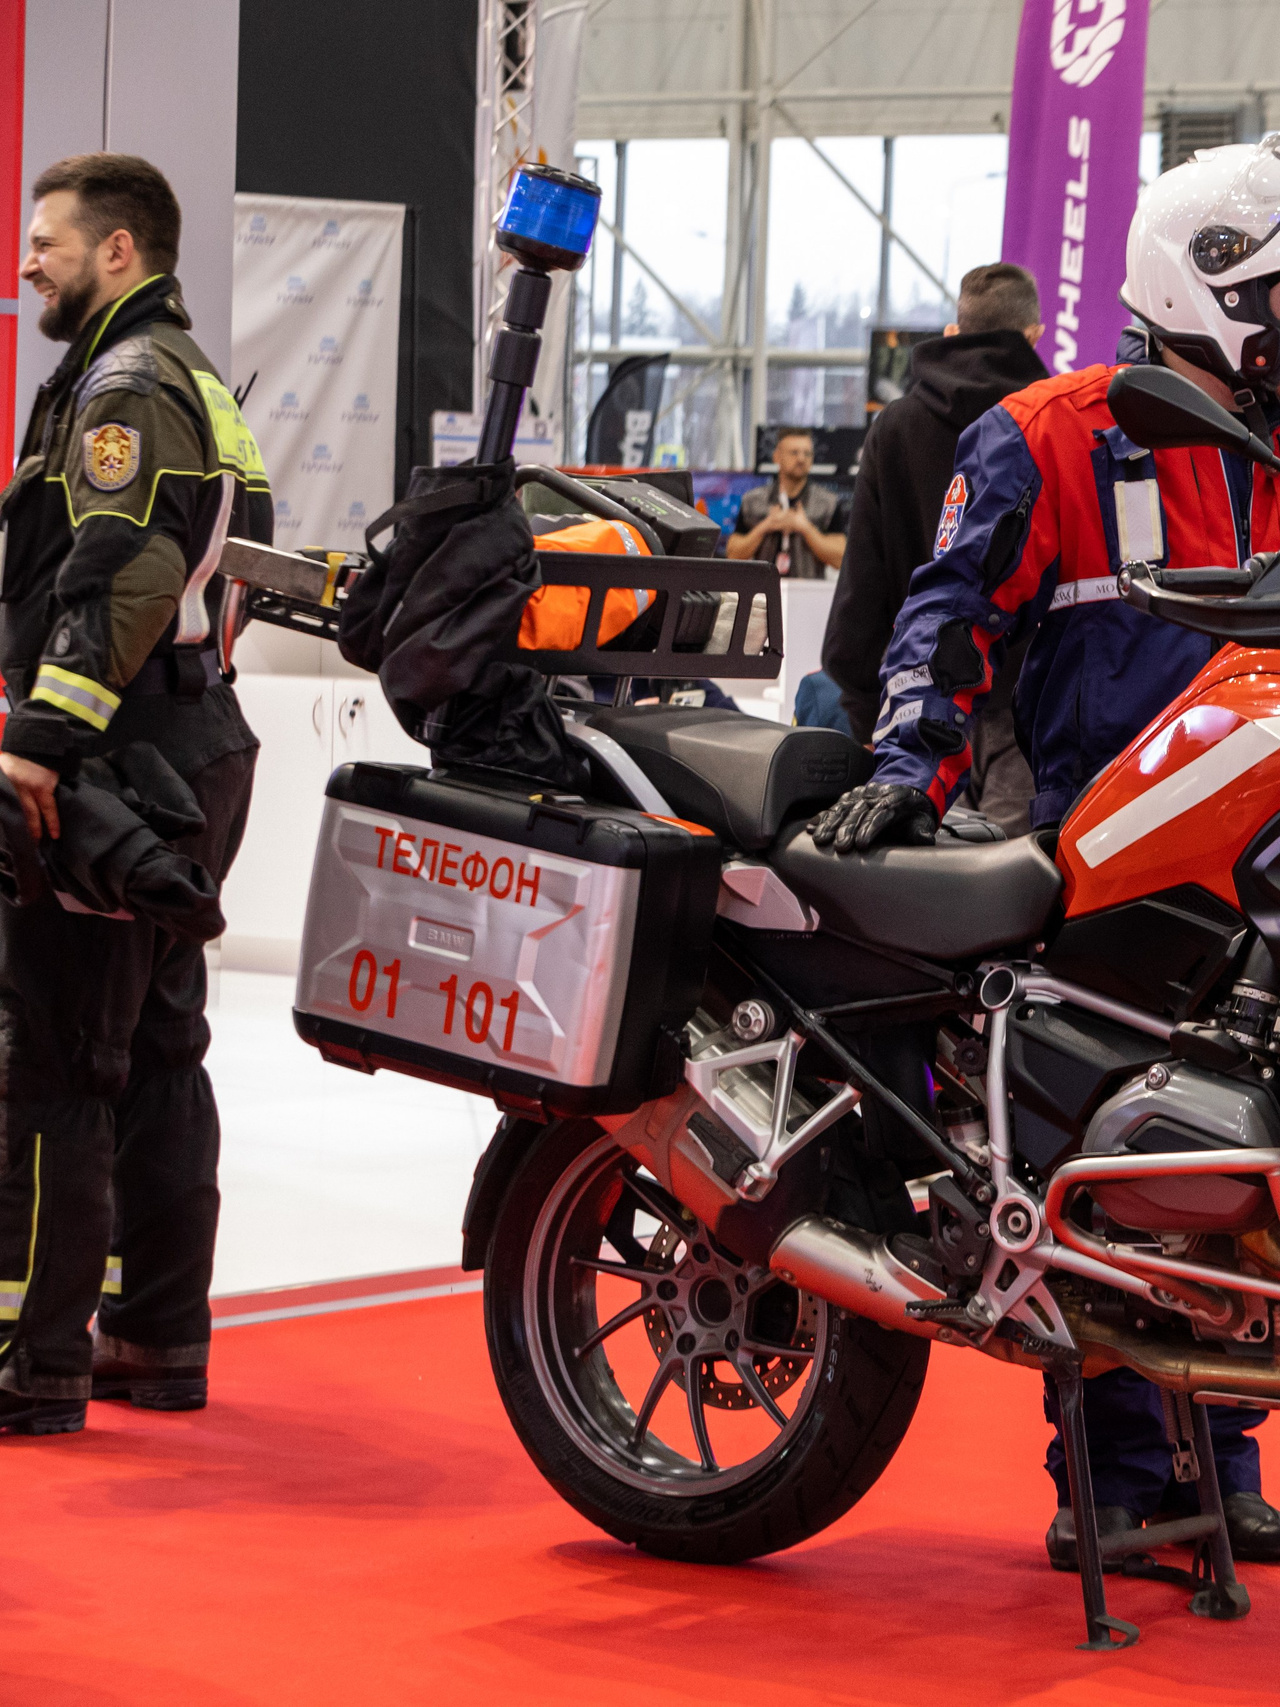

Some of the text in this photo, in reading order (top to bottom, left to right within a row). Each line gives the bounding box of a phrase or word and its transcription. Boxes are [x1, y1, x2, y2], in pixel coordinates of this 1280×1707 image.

[1052, 115, 1091, 374] WHEELS
[374, 826, 542, 907] ТЕЛЕФОН
[348, 949, 521, 1052] 01 101
